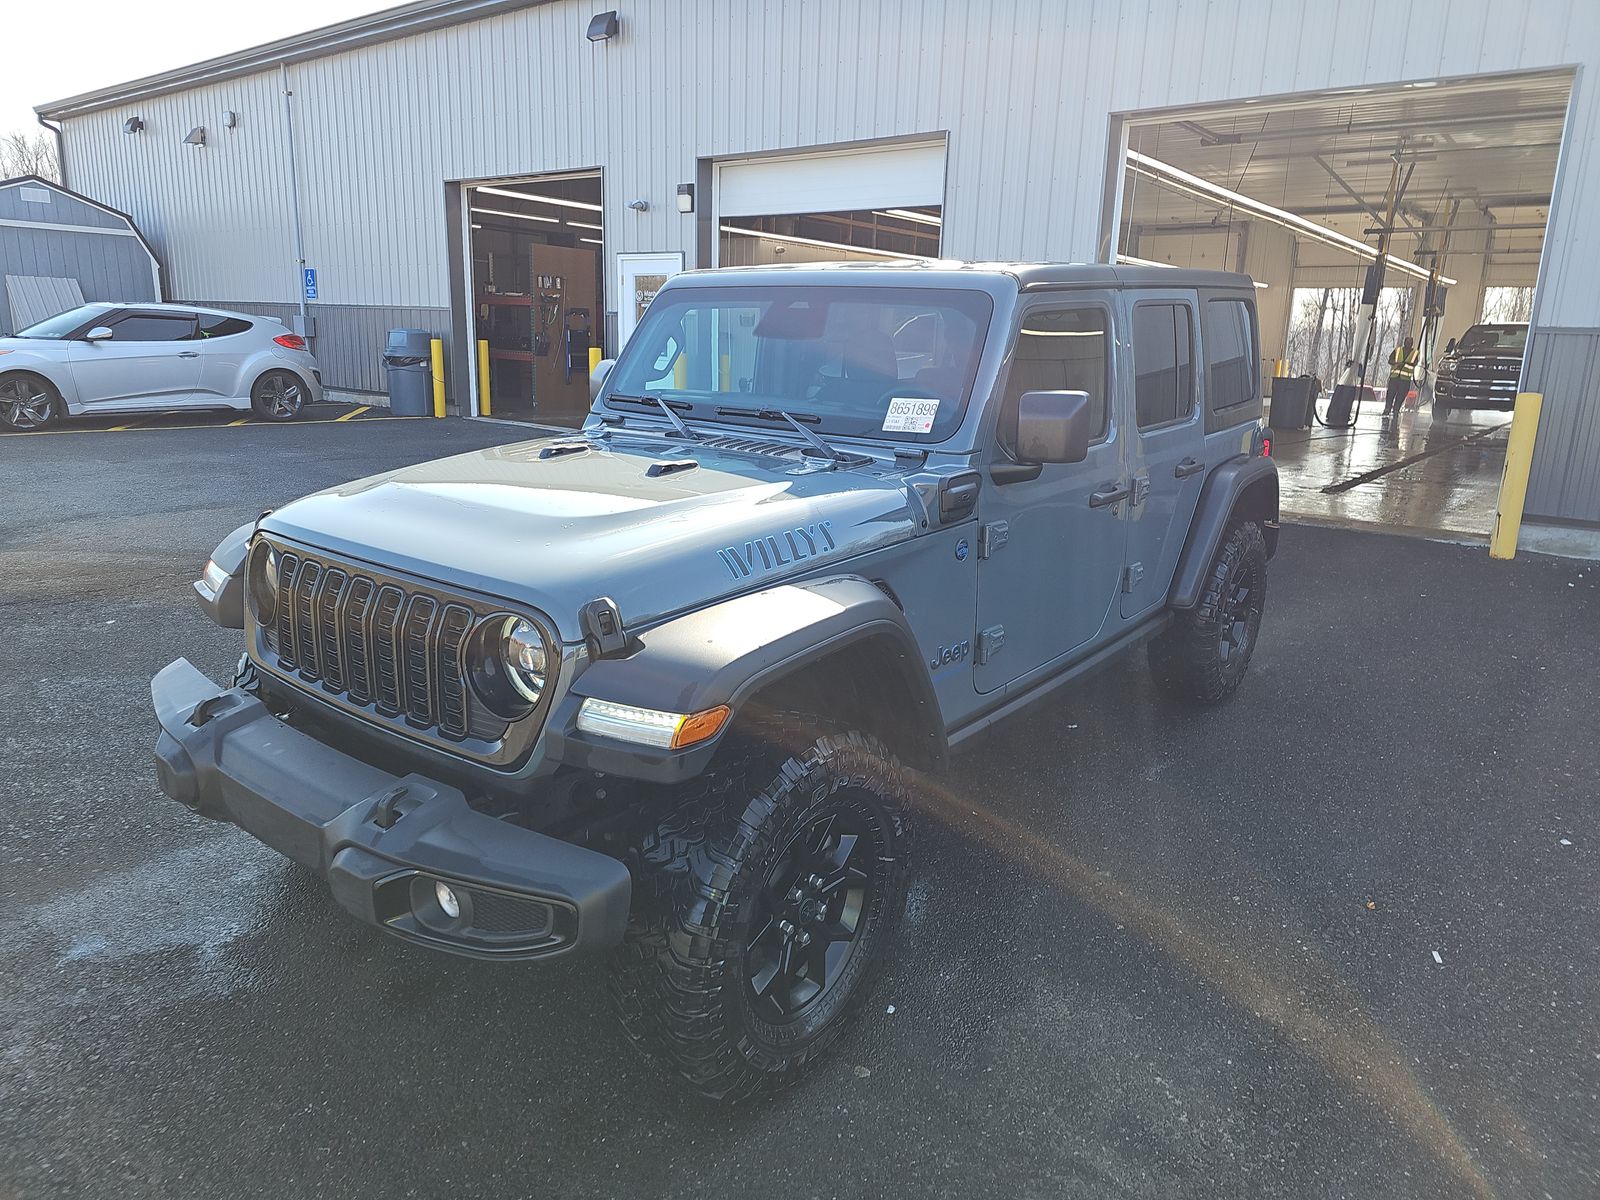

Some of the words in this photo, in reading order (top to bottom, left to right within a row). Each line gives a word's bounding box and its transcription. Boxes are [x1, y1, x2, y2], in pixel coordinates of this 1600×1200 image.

[890, 401, 938, 416] 8651898
[717, 520, 835, 580] WILLYS
[930, 640, 969, 670] Jeep
